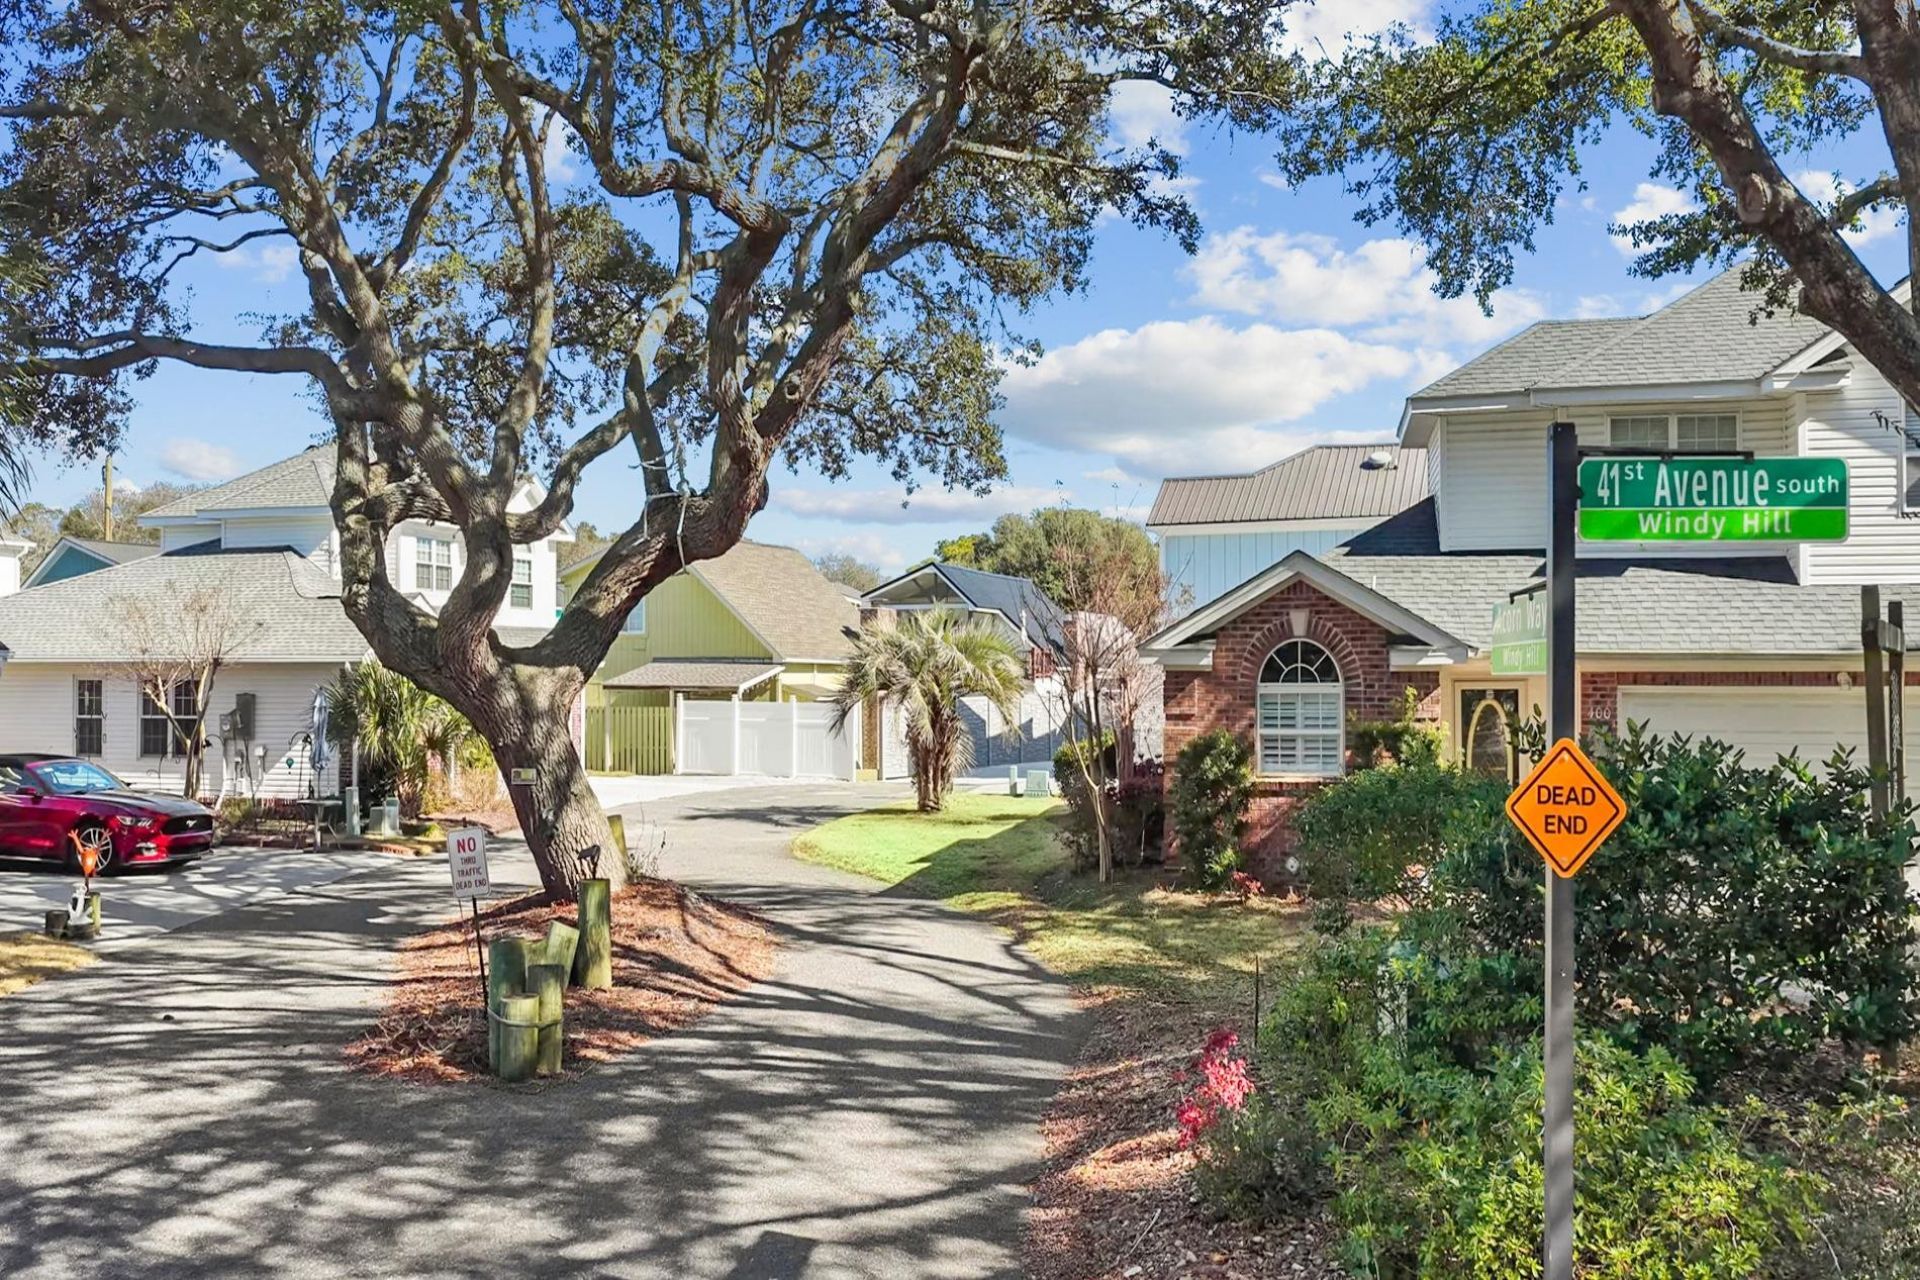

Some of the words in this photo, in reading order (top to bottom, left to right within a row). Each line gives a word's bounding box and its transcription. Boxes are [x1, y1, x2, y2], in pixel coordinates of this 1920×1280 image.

[1597, 461, 1644, 507] 41st
[1654, 463, 1769, 507] Avenue
[1776, 475, 1840, 494] south
[1638, 512, 1726, 539] Windy
[1743, 510, 1792, 534] Hill
[1526, 599, 1547, 637] Way
[1537, 785, 1596, 806] DEAD
[1544, 815, 1588, 835] END
[456, 837, 476, 853] NO
[457, 867, 482, 877] TRAFFIC
[455, 880, 473, 890] DEAD
[474, 878, 487, 888] END
